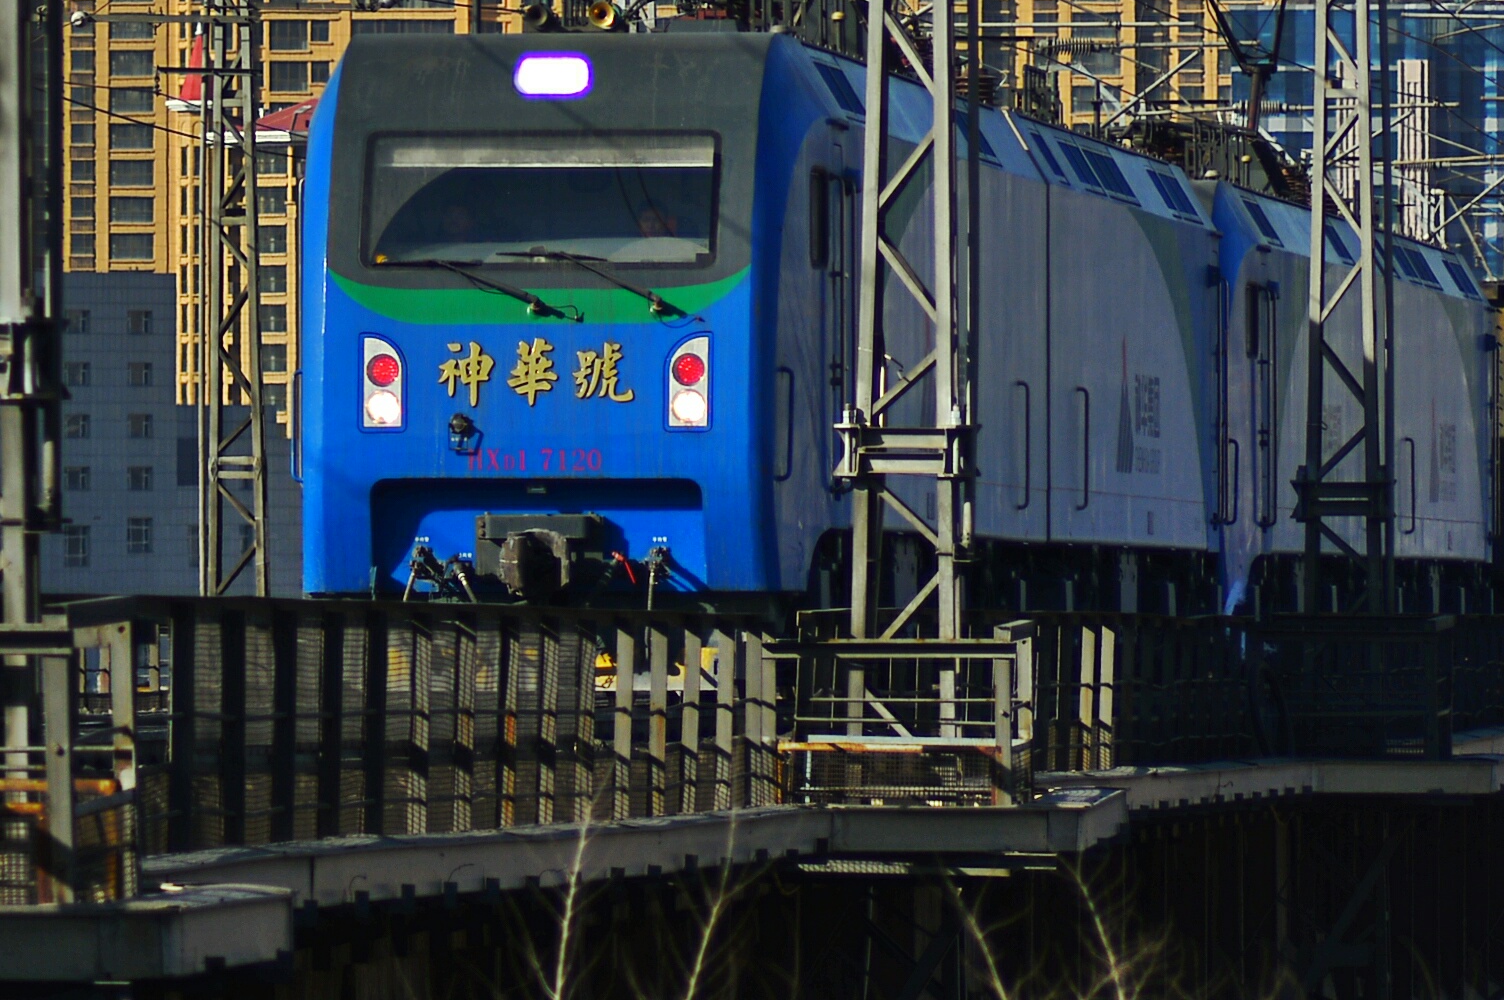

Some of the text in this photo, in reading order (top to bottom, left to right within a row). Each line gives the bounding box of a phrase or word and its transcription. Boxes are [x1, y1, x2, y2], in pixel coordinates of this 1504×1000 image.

[438, 337, 634, 407] 神華號
[541, 448, 603, 471] 7120
